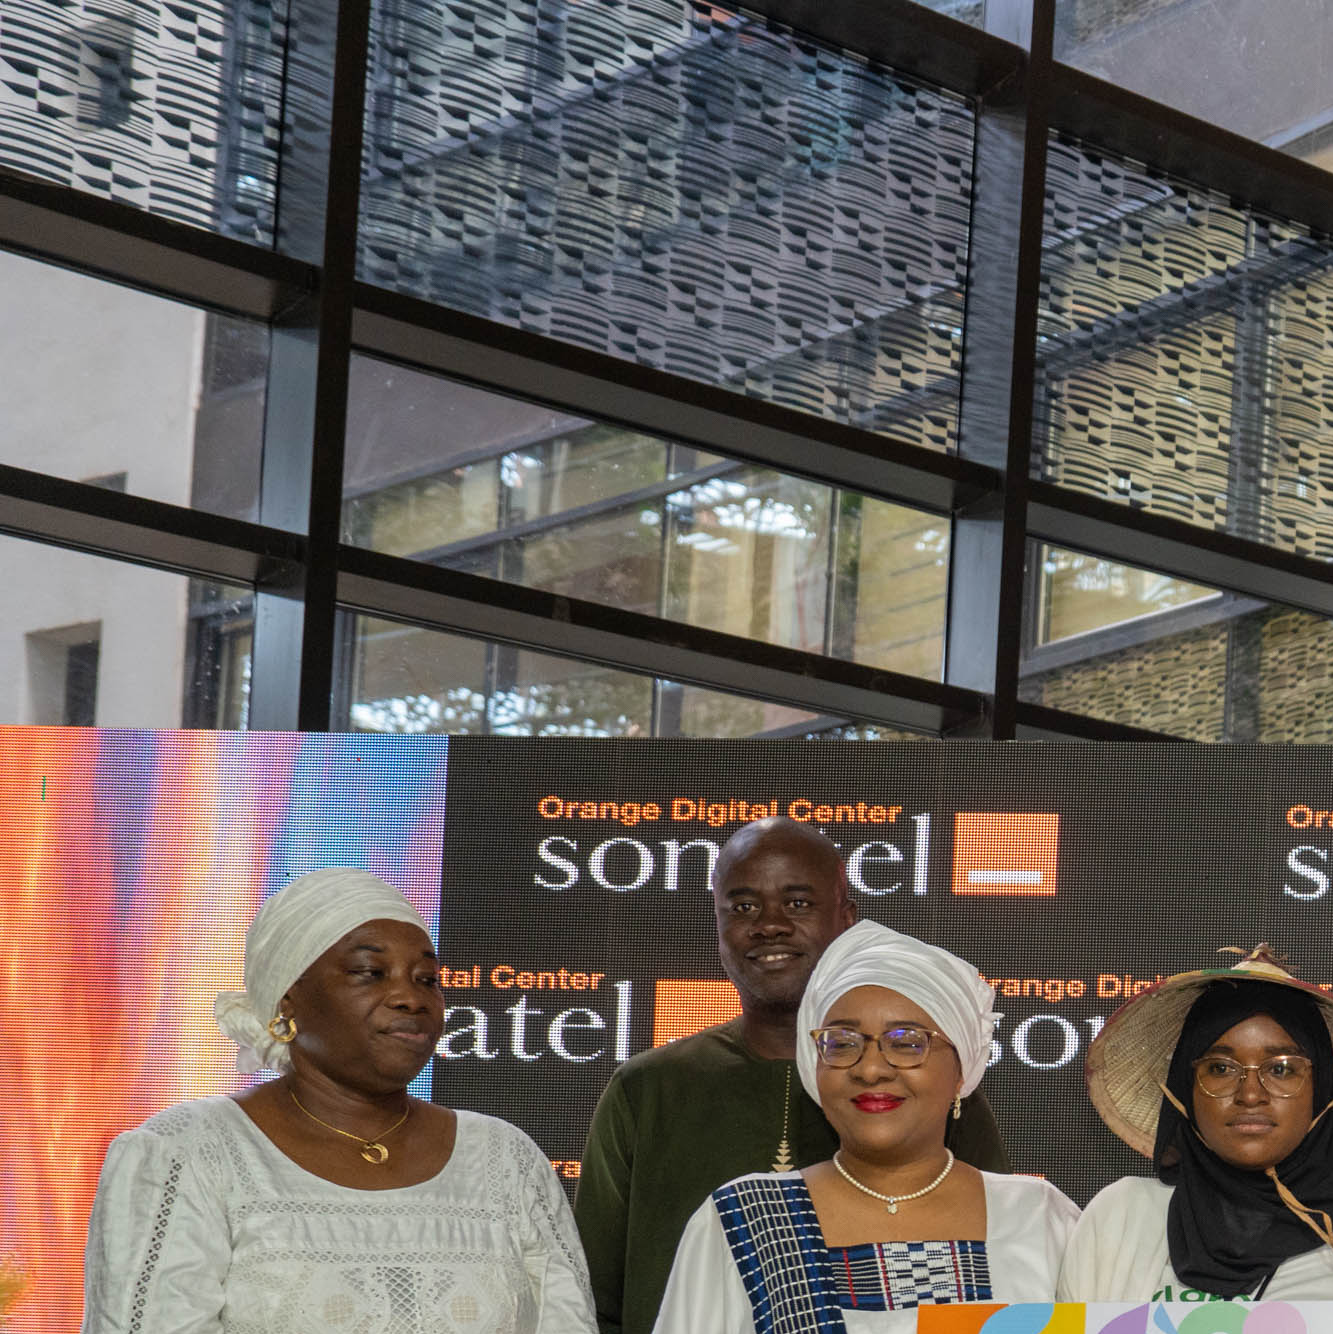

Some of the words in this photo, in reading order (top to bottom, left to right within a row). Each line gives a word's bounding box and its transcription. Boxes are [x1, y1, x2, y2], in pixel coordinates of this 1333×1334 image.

[537, 795, 661, 826] Orange
[671, 797, 778, 827] Digital
[788, 798, 902, 824] Center
[534, 812, 931, 896] sonel
[489, 965, 607, 990] Center
[978, 973, 1087, 1003] range
[435, 980, 633, 1063] atel
